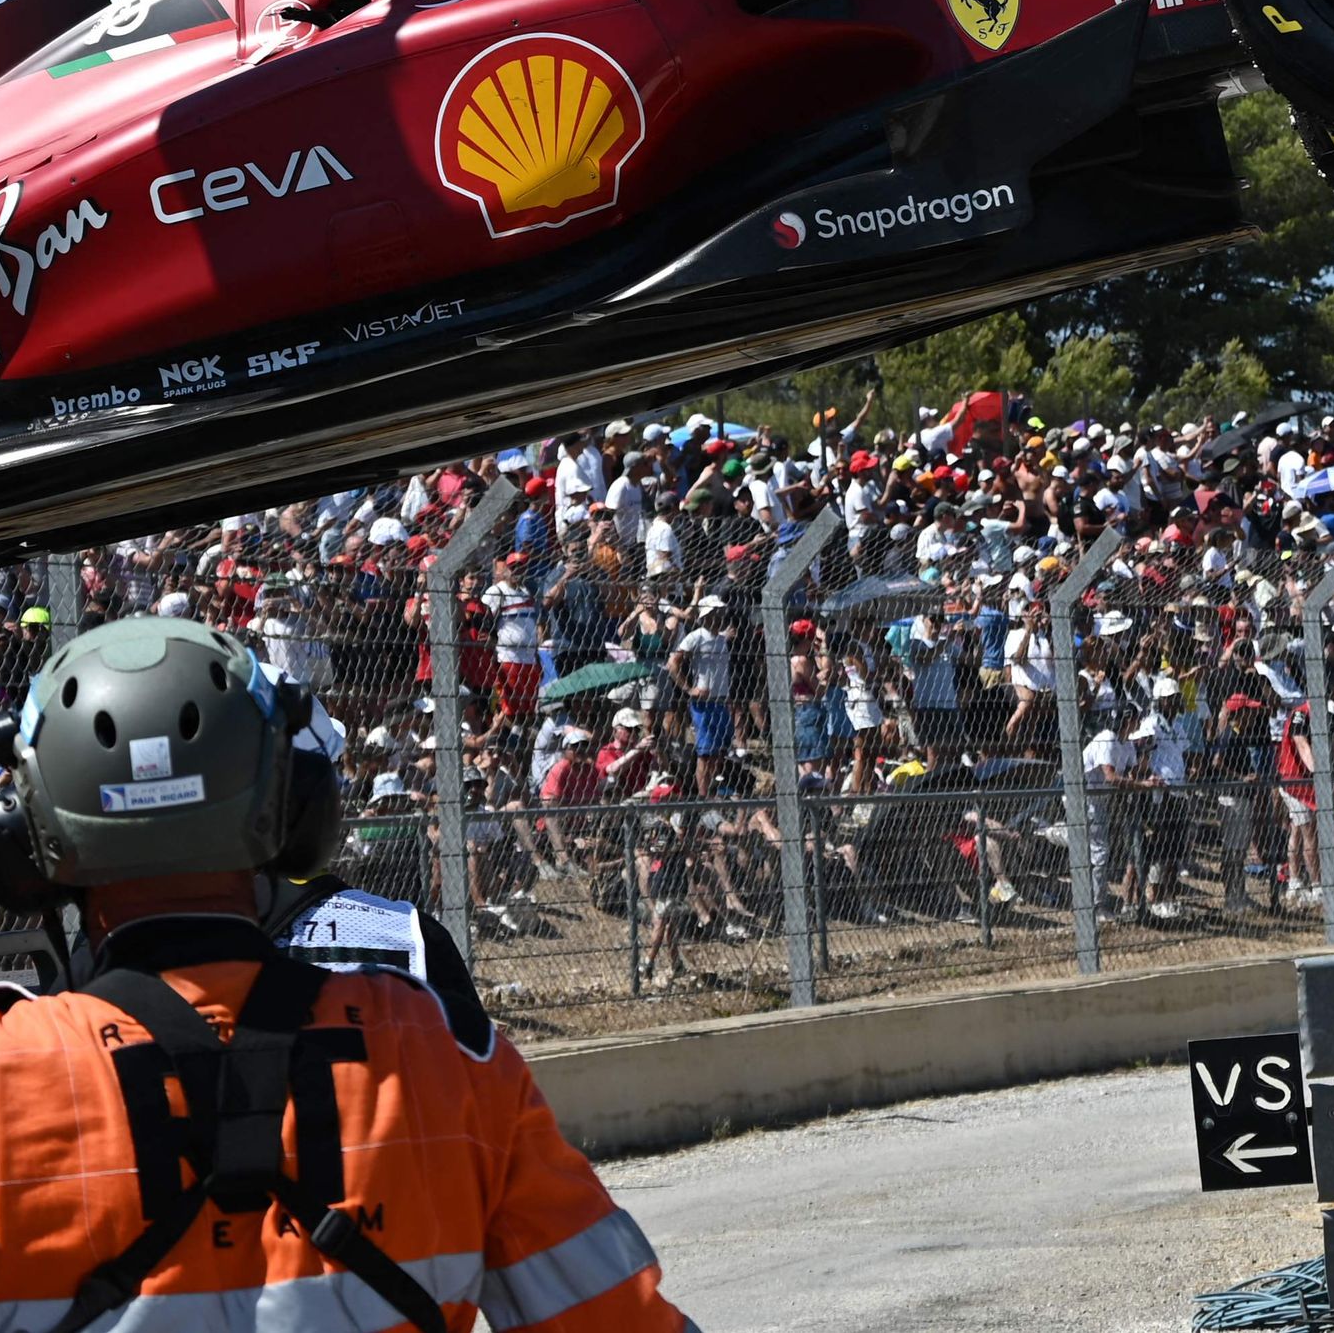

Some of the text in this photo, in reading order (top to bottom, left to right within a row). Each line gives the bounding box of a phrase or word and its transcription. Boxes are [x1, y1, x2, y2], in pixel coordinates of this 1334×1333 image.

[1262, 4, 1303, 34] P
[814, 183, 1016, 239] Snapdragon
[158, 354, 225, 388] NGK
[247, 341, 321, 378] SKF
[51, 385, 141, 417] brembo
[163, 379, 227, 399] SPARK PLUGS
[322, 900, 386, 916] mpionship
[1195, 1056, 1292, 1111] VS
